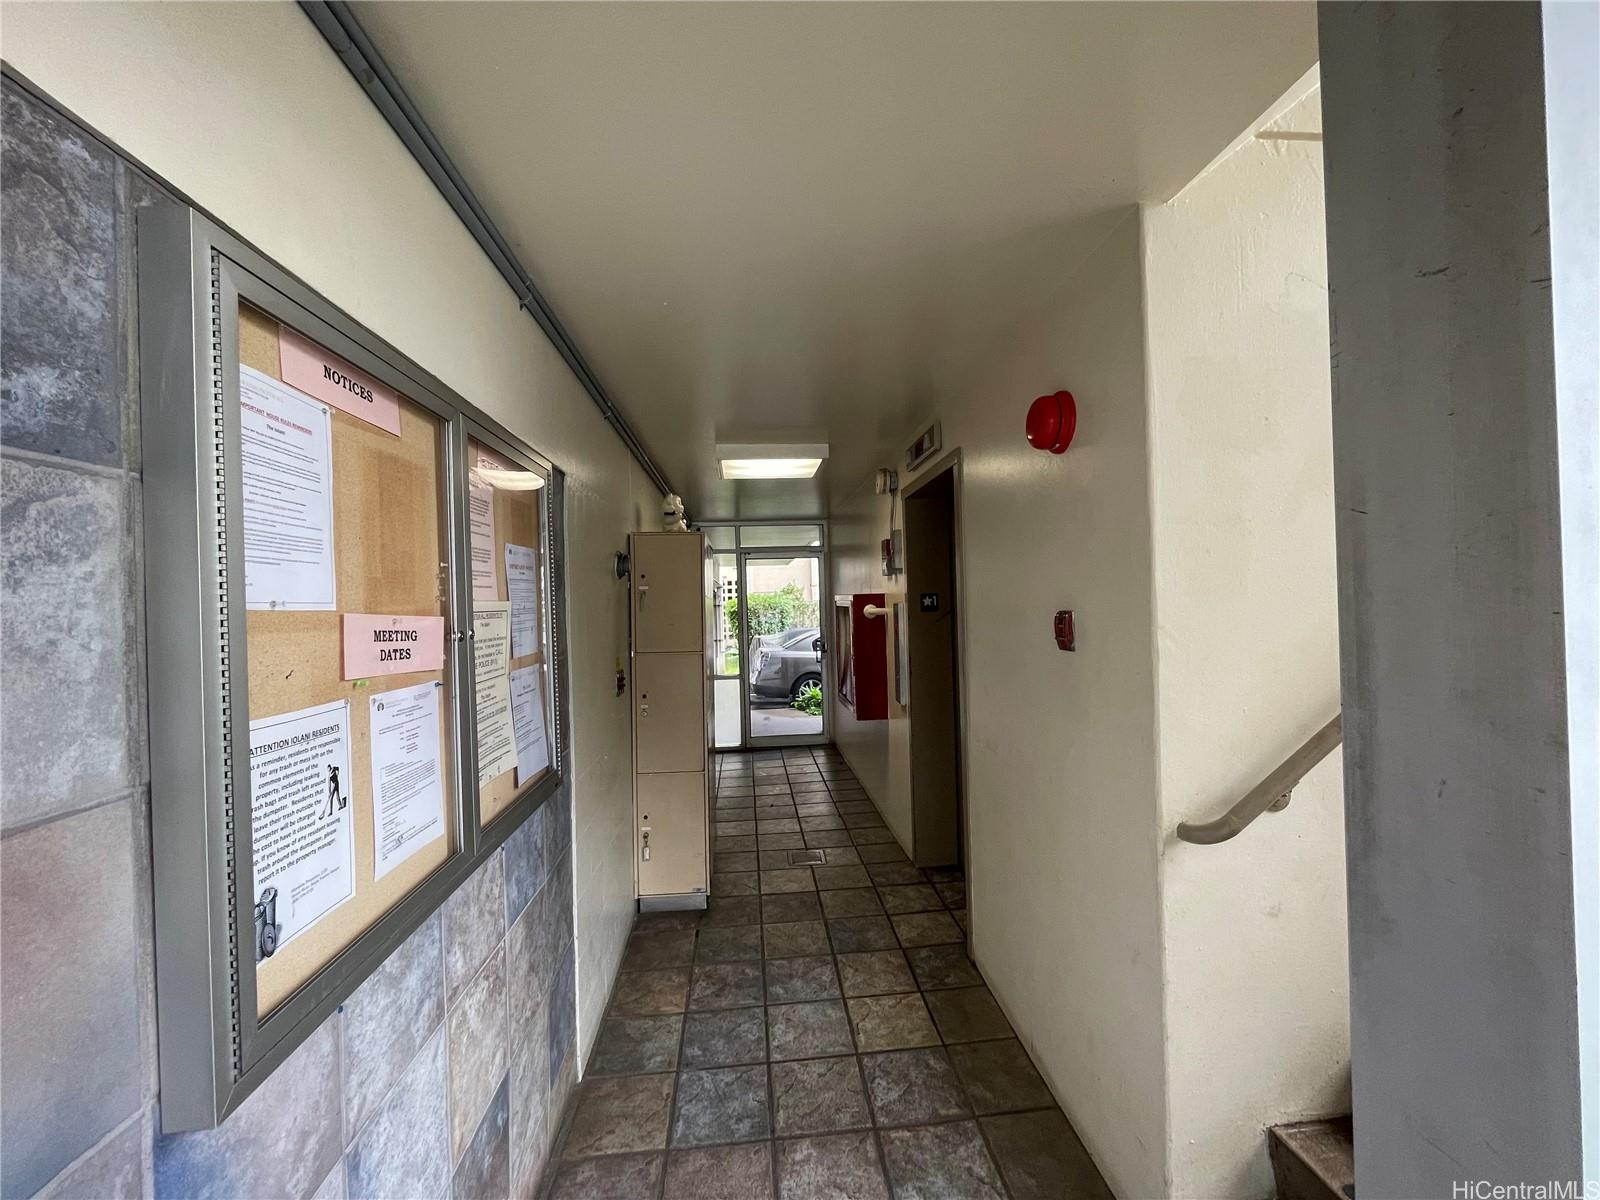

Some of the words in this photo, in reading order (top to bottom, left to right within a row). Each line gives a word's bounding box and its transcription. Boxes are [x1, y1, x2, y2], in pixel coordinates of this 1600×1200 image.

[323, 364, 373, 403] NOTICES
[373, 630, 418, 642] MEETING
[380, 648, 411, 661] DATES
[250, 738, 289, 756] ATTENTION
[291, 732, 310, 745] IOLANI
[312, 724, 340, 737] RESIDENTS
[261, 754, 288, 768] reminder,
[288, 748, 309, 759] residents
[318, 737, 340, 750] responsible
[258, 776, 281, 790] common
[282, 769, 304, 781] elements
[305, 764, 310, 772] of
[260, 770, 268, 779] for
[269, 767, 278, 777] any
[279, 762, 292, 772] trash
[299, 757, 310, 765] mess
[326, 748, 334, 756] the
[251, 803, 264, 813] rash
[265, 798, 276, 809] bags
[278, 793, 287, 802] and
[288, 788, 300, 799] trash
[302, 784, 310, 793] left
[310, 778, 326, 789] around
[256, 788, 280, 802] property,
[282, 778, 304, 791] including
[304, 772, 320, 783] leaking
[252, 814, 262, 824] the
[262, 804, 288, 819] dumpster.
[291, 792, 314, 806] Residents
[315, 788, 324, 796] that
[254, 822, 268, 834] leave
[269, 816, 282, 827] their
[282, 810, 295, 822] trash
[296, 803, 313, 816] outside
[314, 799, 322, 807] the
[254, 829, 279, 845] dumpster
[280, 824, 288, 834] will
[289, 820, 296, 828] be
[296, 811, 316, 825] charged
[261, 842, 273, 852] cost
[273, 838, 279, 846] to
[280, 832, 292, 844] have
[292, 828, 297, 836] it
[297, 820, 316, 834] cleaned
[261, 852, 266, 862] If
[267, 850, 276, 861] you
[277, 842, 290, 854] know
[291, 838, 297, 846] of
[298, 834, 307, 845] any
[307, 824, 325, 838] resident
[257, 863, 272, 875] trash
[272, 853, 290, 868] around
[290, 848, 299, 856] the
[258, 872, 274, 886] report
[275, 868, 280, 877] it
[280, 864, 286, 872] to
[287, 860, 295, 868] the
[295, 850, 317, 864] property
